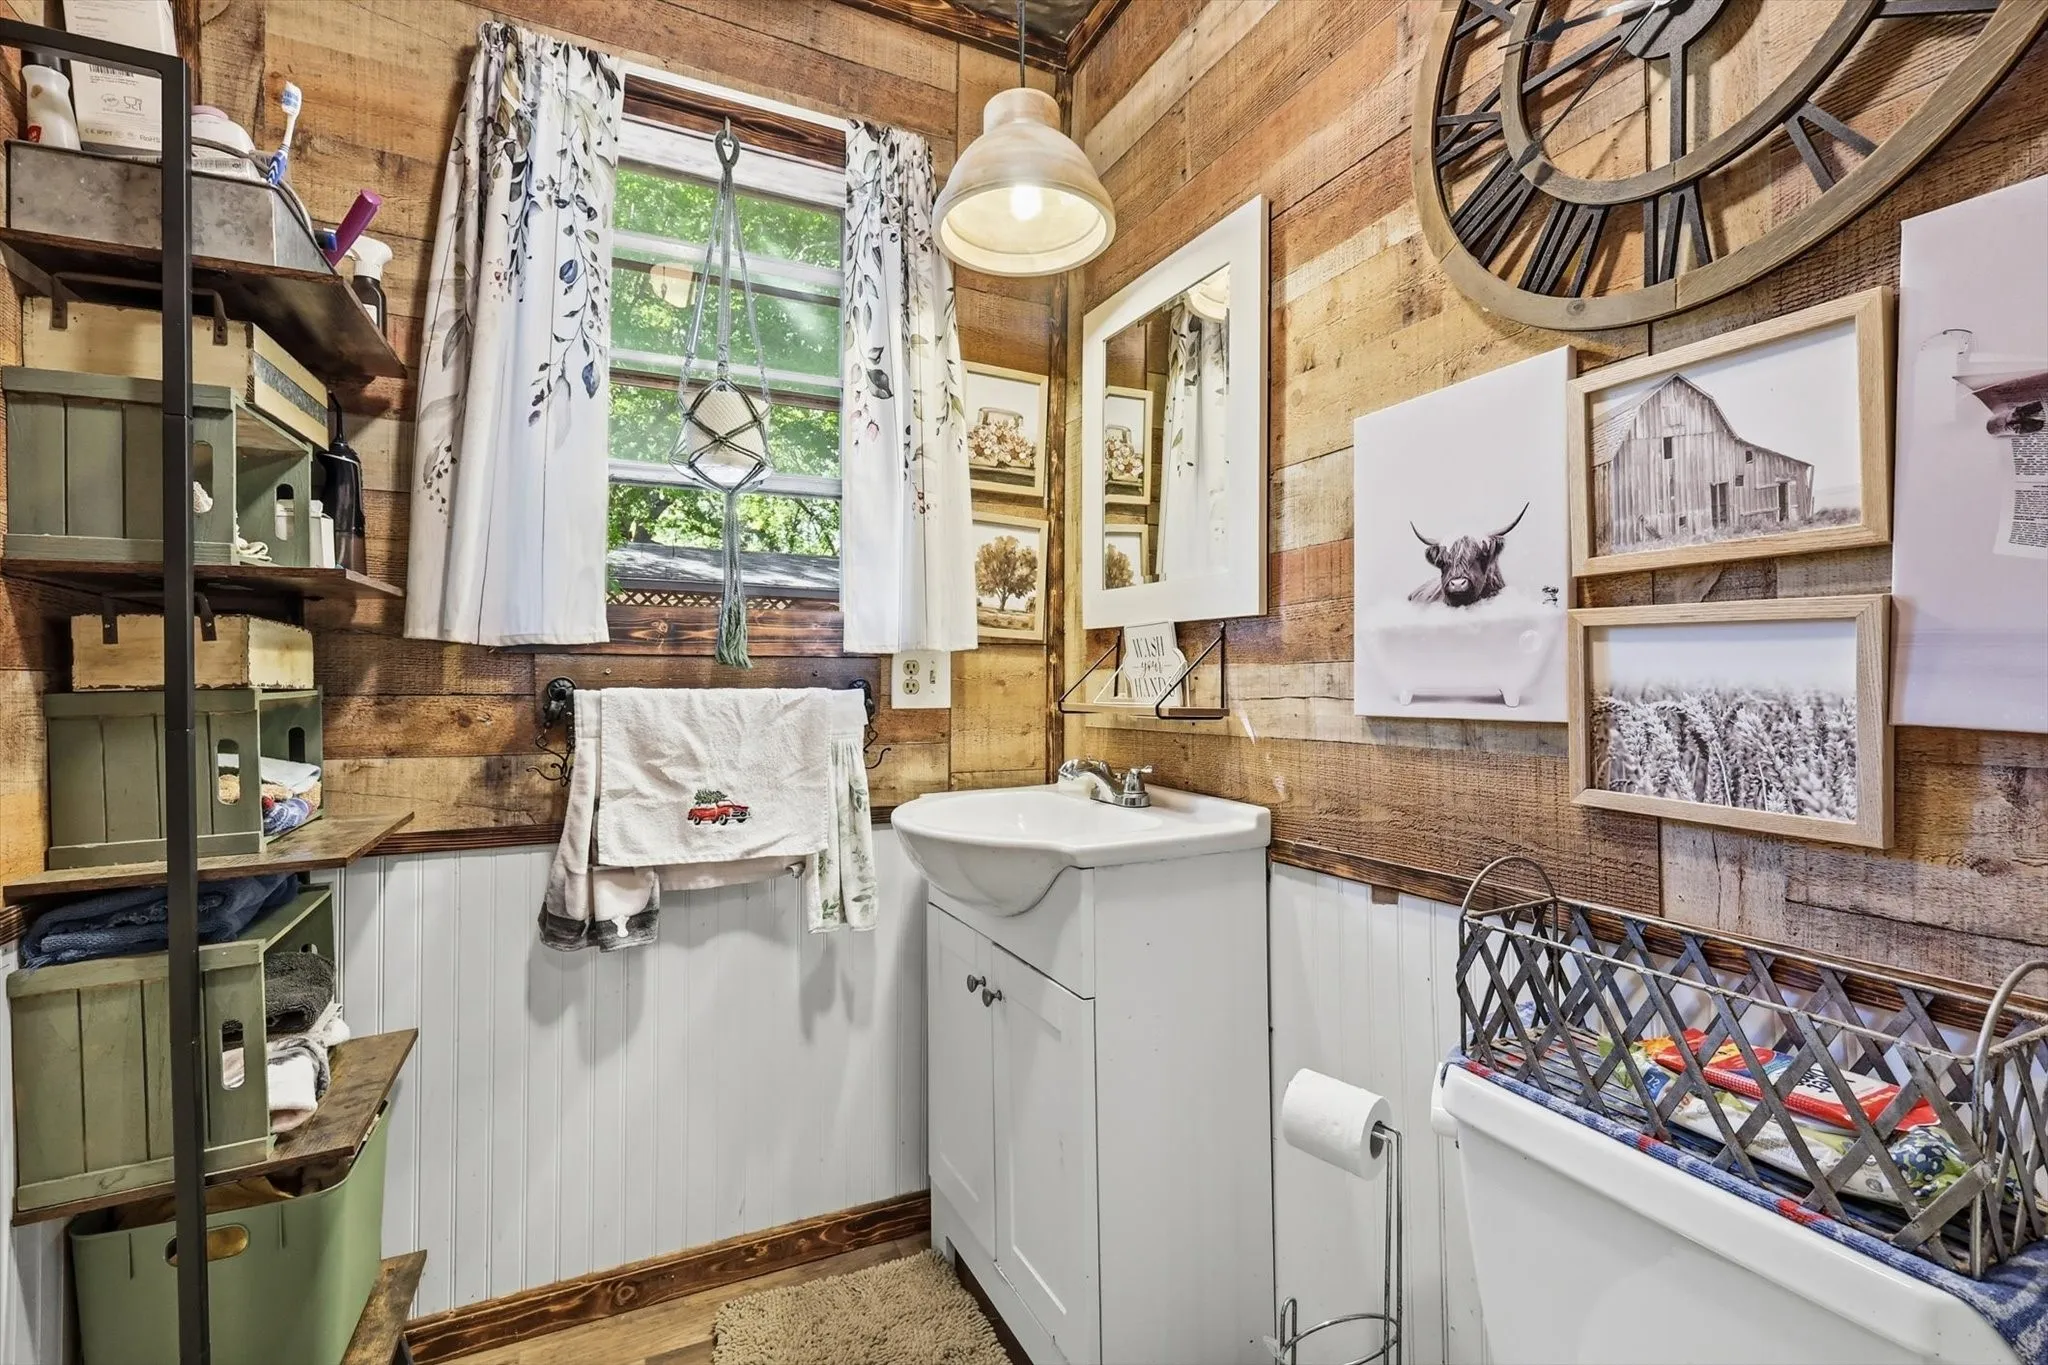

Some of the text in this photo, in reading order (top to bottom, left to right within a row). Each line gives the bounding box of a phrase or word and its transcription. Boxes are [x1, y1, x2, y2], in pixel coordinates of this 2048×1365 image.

[1132, 635, 1165, 658] WASH
[1141, 658, 1163, 678] your
[1645, 1074, 1661, 1087] 72
